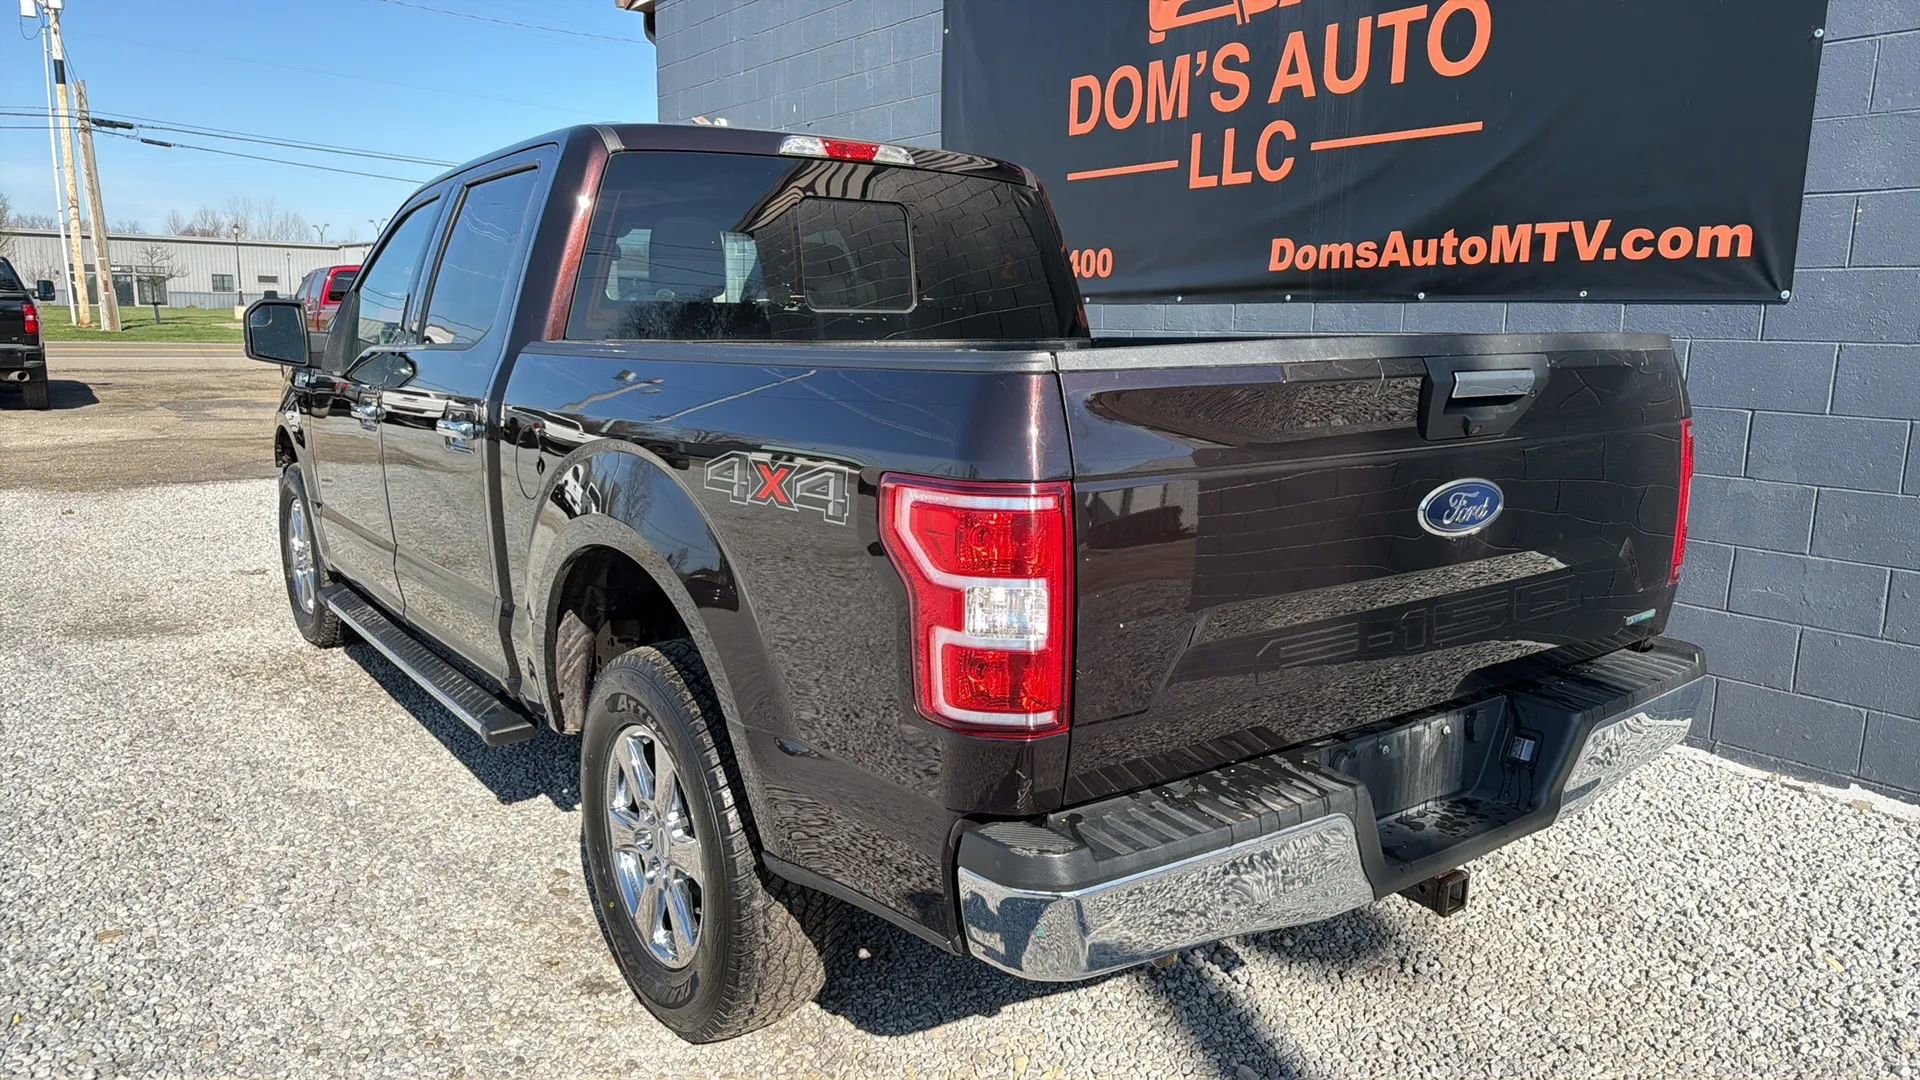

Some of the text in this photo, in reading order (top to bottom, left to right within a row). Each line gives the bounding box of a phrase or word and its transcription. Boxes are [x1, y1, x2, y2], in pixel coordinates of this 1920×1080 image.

[1068, 0, 1492, 136] DOM'S AUTO
[1189, 119, 1298, 189] LLC
[1268, 218, 1754, 272] DomsAutoMTV.com
[1442, 490, 1490, 525] Ford
[1255, 576, 1584, 687] F-150
